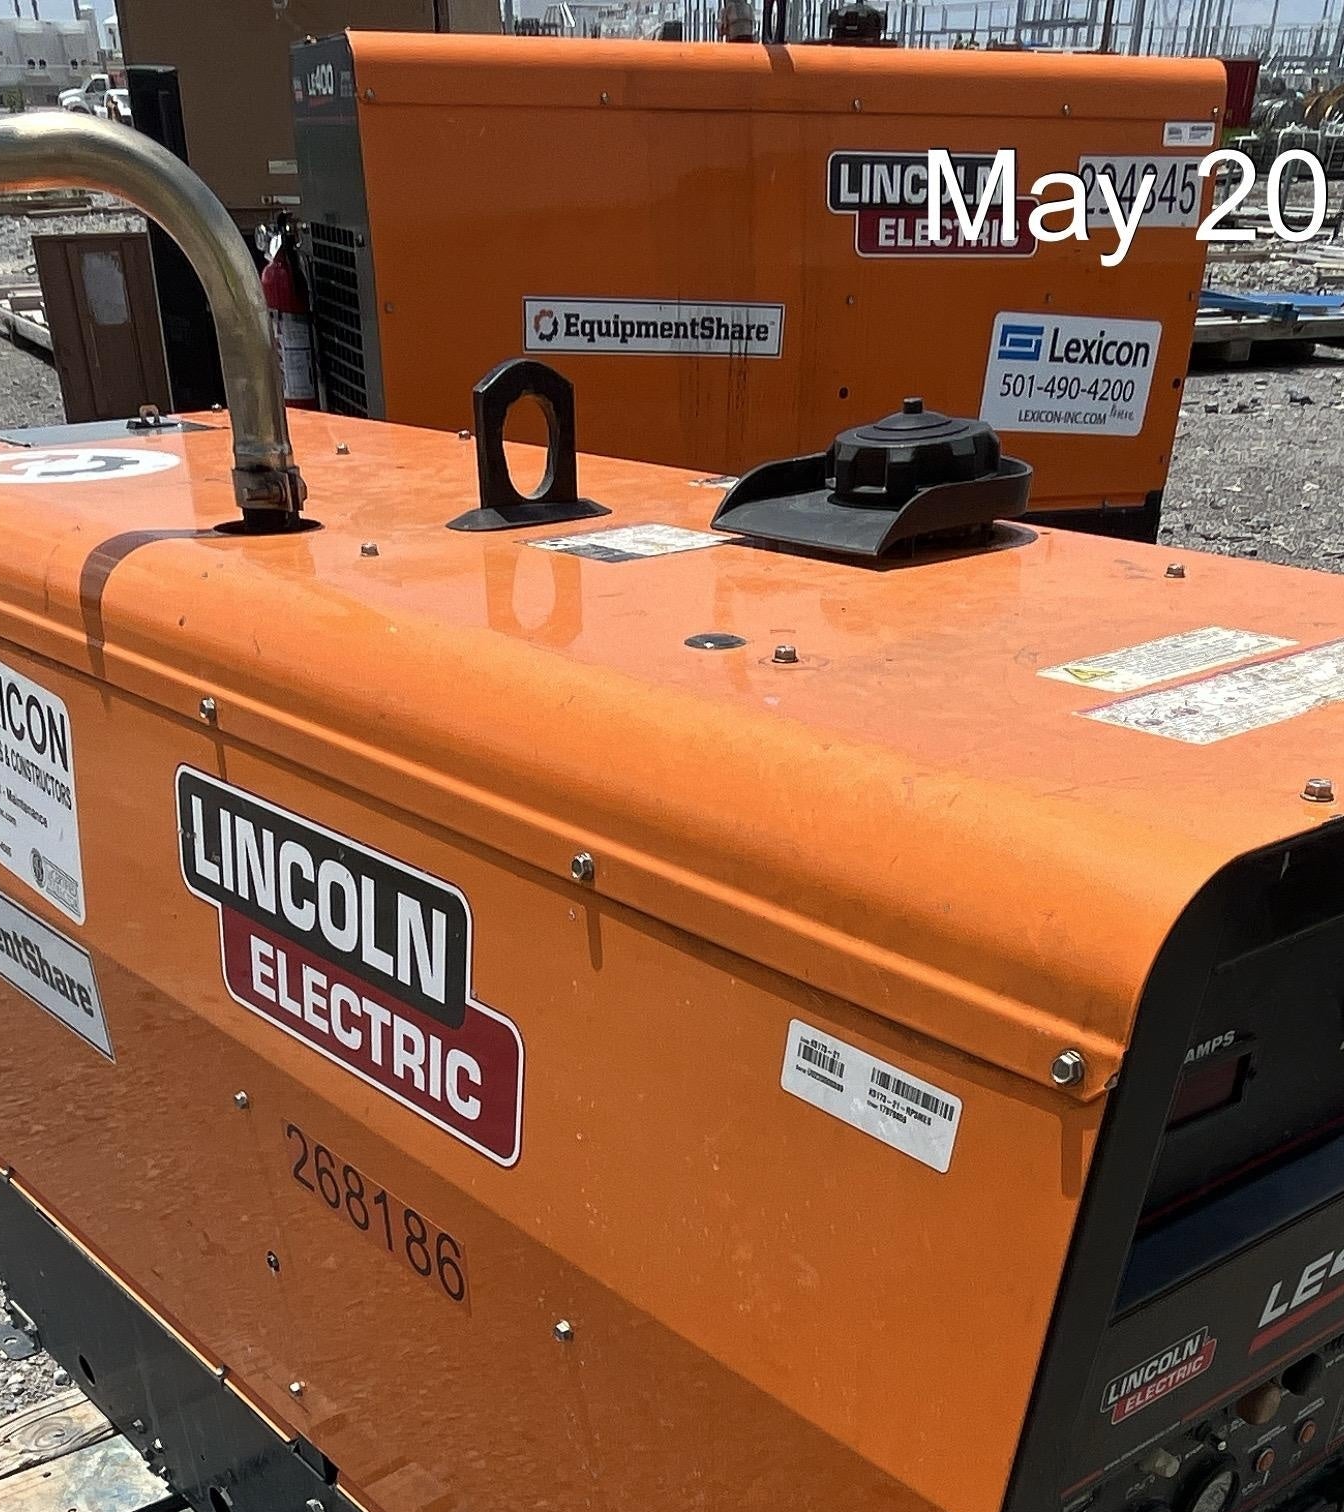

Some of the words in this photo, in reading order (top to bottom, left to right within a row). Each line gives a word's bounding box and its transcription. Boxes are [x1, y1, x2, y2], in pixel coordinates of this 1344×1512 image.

[564, 313, 770, 343] EquipmentShare
[1048, 327, 1150, 368] Lexicon
[1000, 374, 1136, 403] 501-490-4200
[1018, 409, 1107, 425] LEXICON-INC.COM
[11, 749, 72, 811] CONSTRUCTORS
[190, 794, 448, 1005] LINCOLN
[250, 935, 484, 1121] ELECTRIC
[1184, 1030, 1236, 1064] AMPS
[285, 1123, 466, 1303] 268186
[1108, 1334, 1201, 1405] LINCOLN
[1124, 1356, 1204, 1414] ELECTRIC
